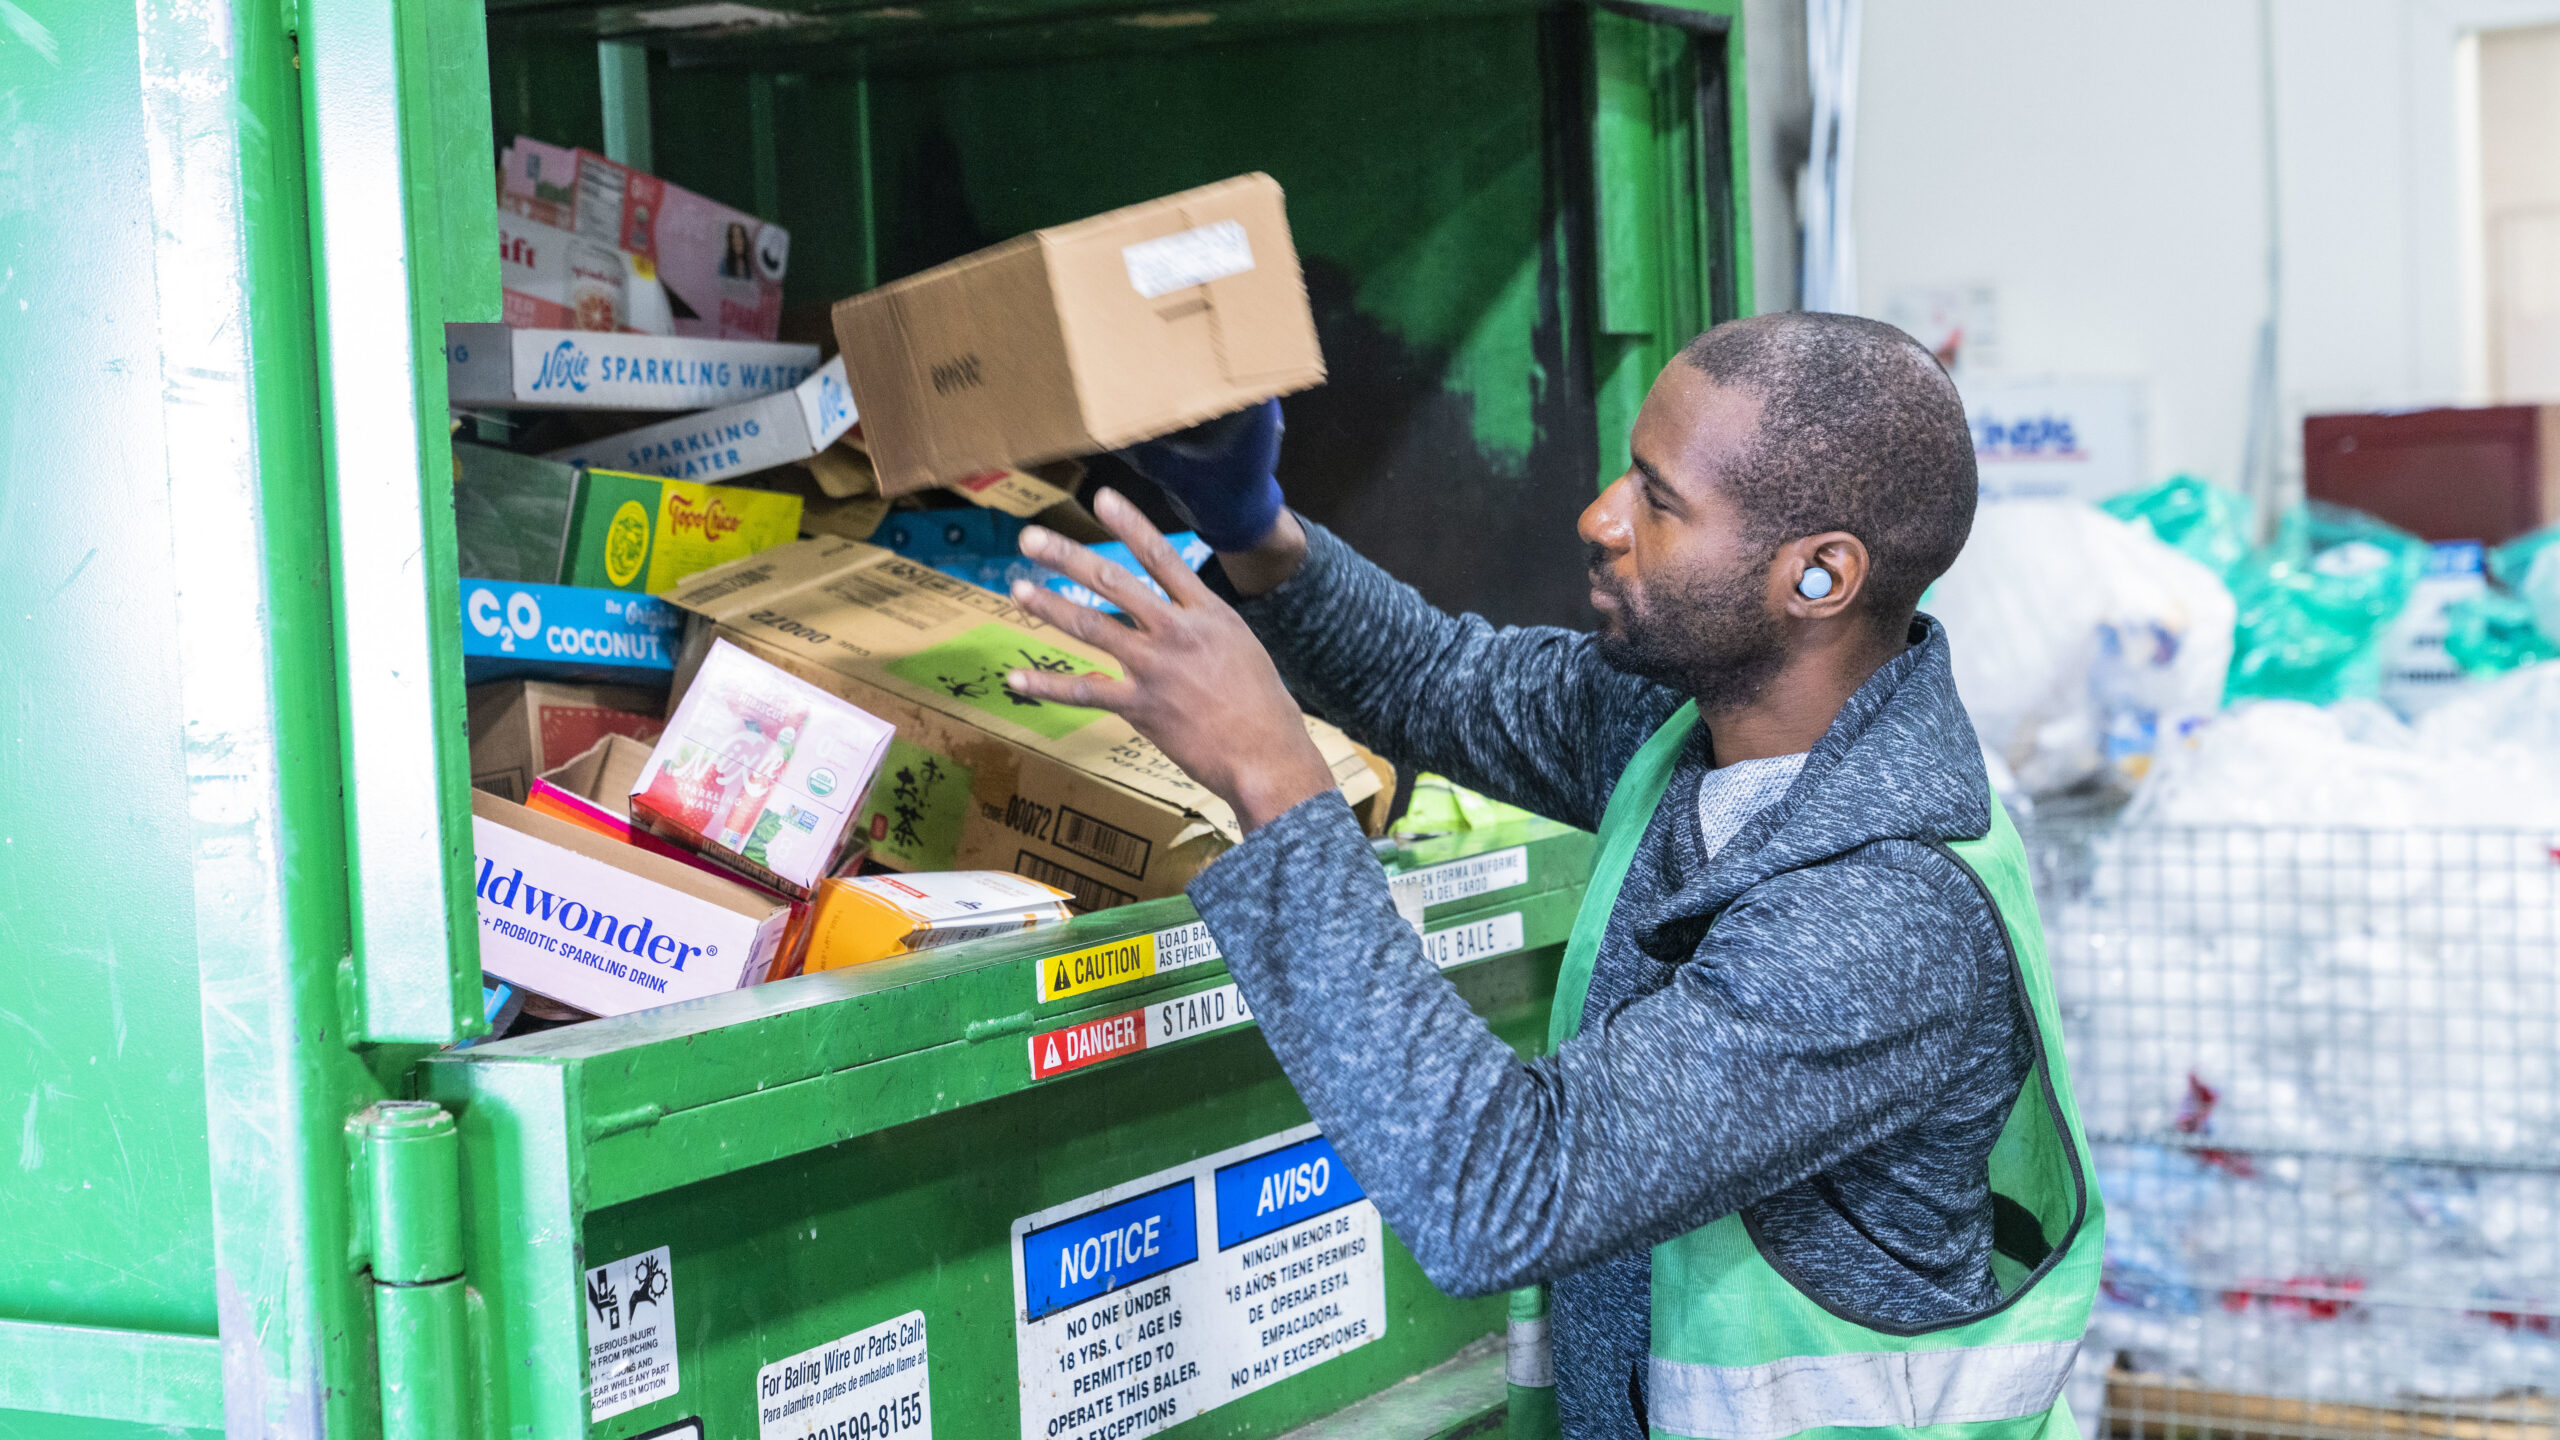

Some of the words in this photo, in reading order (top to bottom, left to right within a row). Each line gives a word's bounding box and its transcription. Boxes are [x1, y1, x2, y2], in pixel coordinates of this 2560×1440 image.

[532, 340, 590, 393] Nixie
[602, 355, 731, 387] SPARKLING
[627, 419, 760, 468] SPARKLING
[660, 449, 741, 479] WATER
[546, 626, 659, 661] COCONUT
[678, 782, 743, 807] SPARKLING
[685, 797, 726, 815] WATER
[1005, 794, 1053, 841] 00072
[1436, 866, 1469, 883] FORMA
[1471, 854, 1519, 876] UNIFORME
[1438, 885, 1454, 900] DEL
[1458, 877, 1488, 894] FARDO
[493, 918, 558, 952] PROBIOTIC
[559, 943, 629, 978] SPARKLING
[628, 968, 668, 993] DRINK
[1158, 927, 1188, 950] LOAD
[1159, 953, 1173, 968] AS
[1175, 940, 1212, 964] EVENLY
[1457, 923, 1494, 957] BALE
[1074, 944, 1140, 984] CAUTION
[1163, 992, 1225, 1036] STAND
[1066, 1016, 1136, 1062] DANGER
[1256, 1156, 1331, 1217] AVISO
[1060, 1215, 1161, 1289] NOTICE
[1242, 1237, 1288, 1270] NINGÚN
[1292, 1223, 1332, 1250] MENOR
[1336, 1216, 1350, 1235] DE
[1227, 1285, 1241, 1304] 18
[1245, 1271, 1277, 1297] AÑOS
[1280, 1257, 1313, 1283] TIENE
[1318, 1237, 1366, 1270] PERMISO
[1067, 1317, 1087, 1340] NO
[1091, 1304, 1119, 1330] ONE
[1125, 1285, 1171, 1318] UNDER
[1249, 1304, 1264, 1324] DE
[1271, 1283, 1317, 1315] OPERAR
[1321, 1271, 1349, 1296] ESTA
[594, 1336, 628, 1355] SERIOUS
[629, 1325, 657, 1342] INJURY
[1059, 1352, 1075, 1373] 18
[1079, 1339, 1111, 1364] YRS.
[1137, 1317, 1164, 1343] AGE
[1169, 1310, 1182, 1329] IS
[1262, 1302, 1343, 1348] EMPACADORA.
[598, 1351, 620, 1365] FROM
[622, 1338, 659, 1359] PINCHING
[637, 1357, 653, 1370] AND
[762, 1374, 781, 1399] For
[784, 1360, 821, 1391] Baling
[824, 1349, 850, 1376] Wire
[853, 1343, 866, 1365] or
[868, 1330, 897, 1360] Parts
[900, 1318, 924, 1347] Call:
[1073, 1351, 1152, 1397] PERMITTED
[1156, 1342, 1174, 1363] TO
[1231, 1368, 1249, 1389] NO
[1254, 1354, 1279, 1380] HAY
[1284, 1318, 1367, 1367] EXCEPCIONES
[591, 1394, 619, 1409] ACHINE
[620, 1390, 627, 1400] IS
[629, 1387, 636, 1397] IN
[638, 1377, 666, 1393] MOTION
[611, 1377, 635, 1391] WHILE
[635, 1371, 650, 1382] ANY
[651, 1363, 670, 1376] PART
[763, 1407, 781, 1425] Para
[783, 1393, 815, 1415] alambre
[815, 1391, 821, 1404] o
[822, 1380, 847, 1402] partes
[848, 1376, 858, 1392] de
[859, 1362, 895, 1388] embalado
[896, 1356, 916, 1373] llame
[917, 1348, 926, 1366] al:
[1048, 1396, 1113, 1437] OPERATE
[1117, 1381, 1149, 1408] THIS
[1153, 1361, 1200, 1394] BALER.
[1089, 1398, 1177, 1440] EXCEPTIONS
